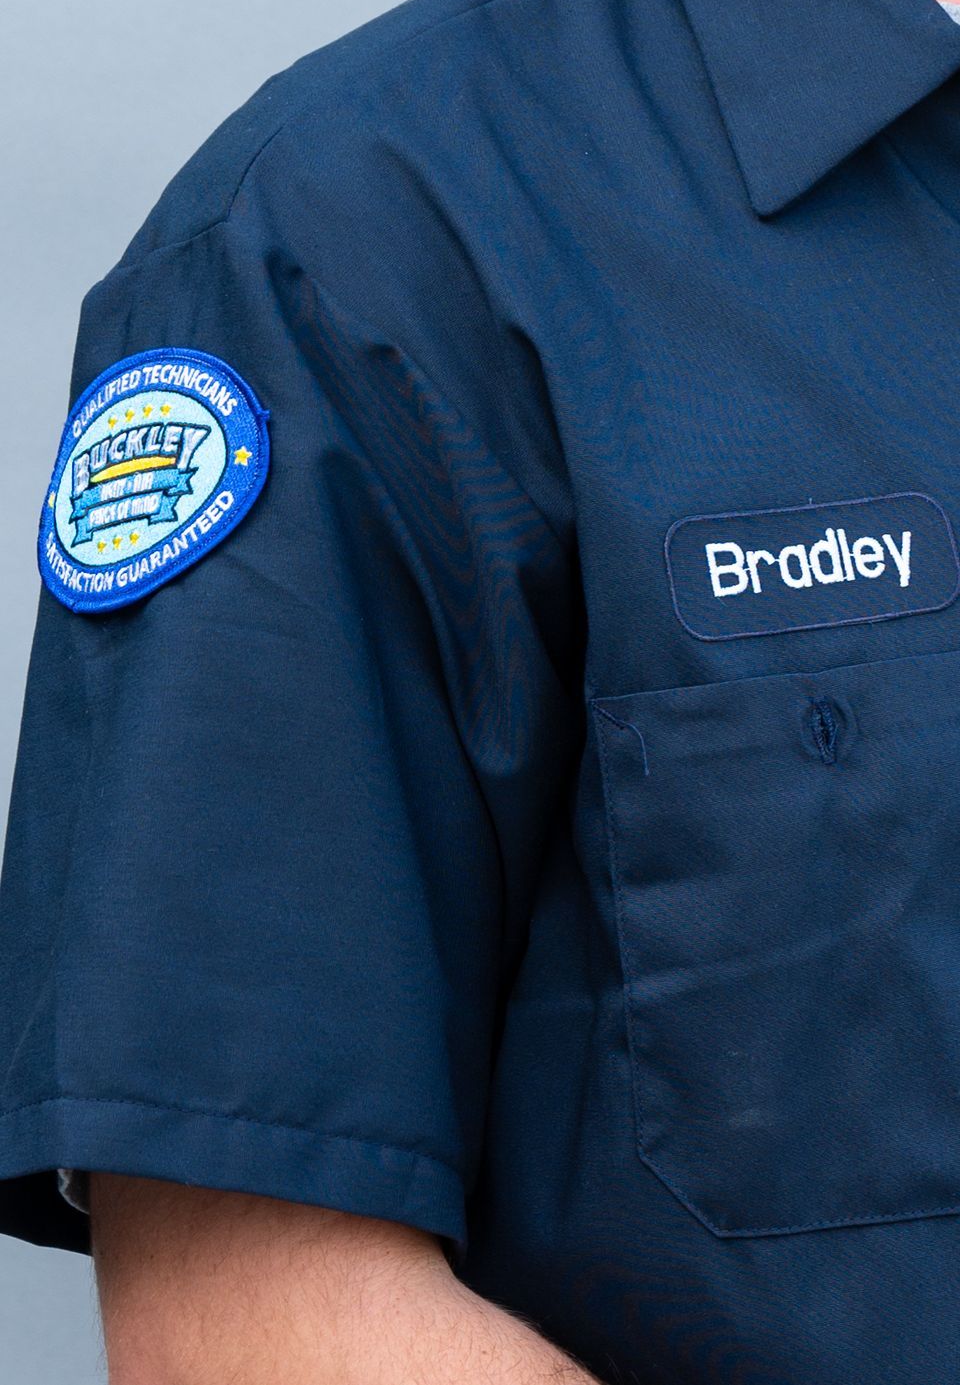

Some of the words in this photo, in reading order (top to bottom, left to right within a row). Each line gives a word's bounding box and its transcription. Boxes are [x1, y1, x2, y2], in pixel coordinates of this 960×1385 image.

[73, 370, 140, 438] QUALIFIED
[143, 365, 238, 417] TECHNICIANS
[72, 423, 211, 497] BUCKLEY
[117, 490, 235, 588] GUARANTEED
[705, 527, 912, 598] Bradley
